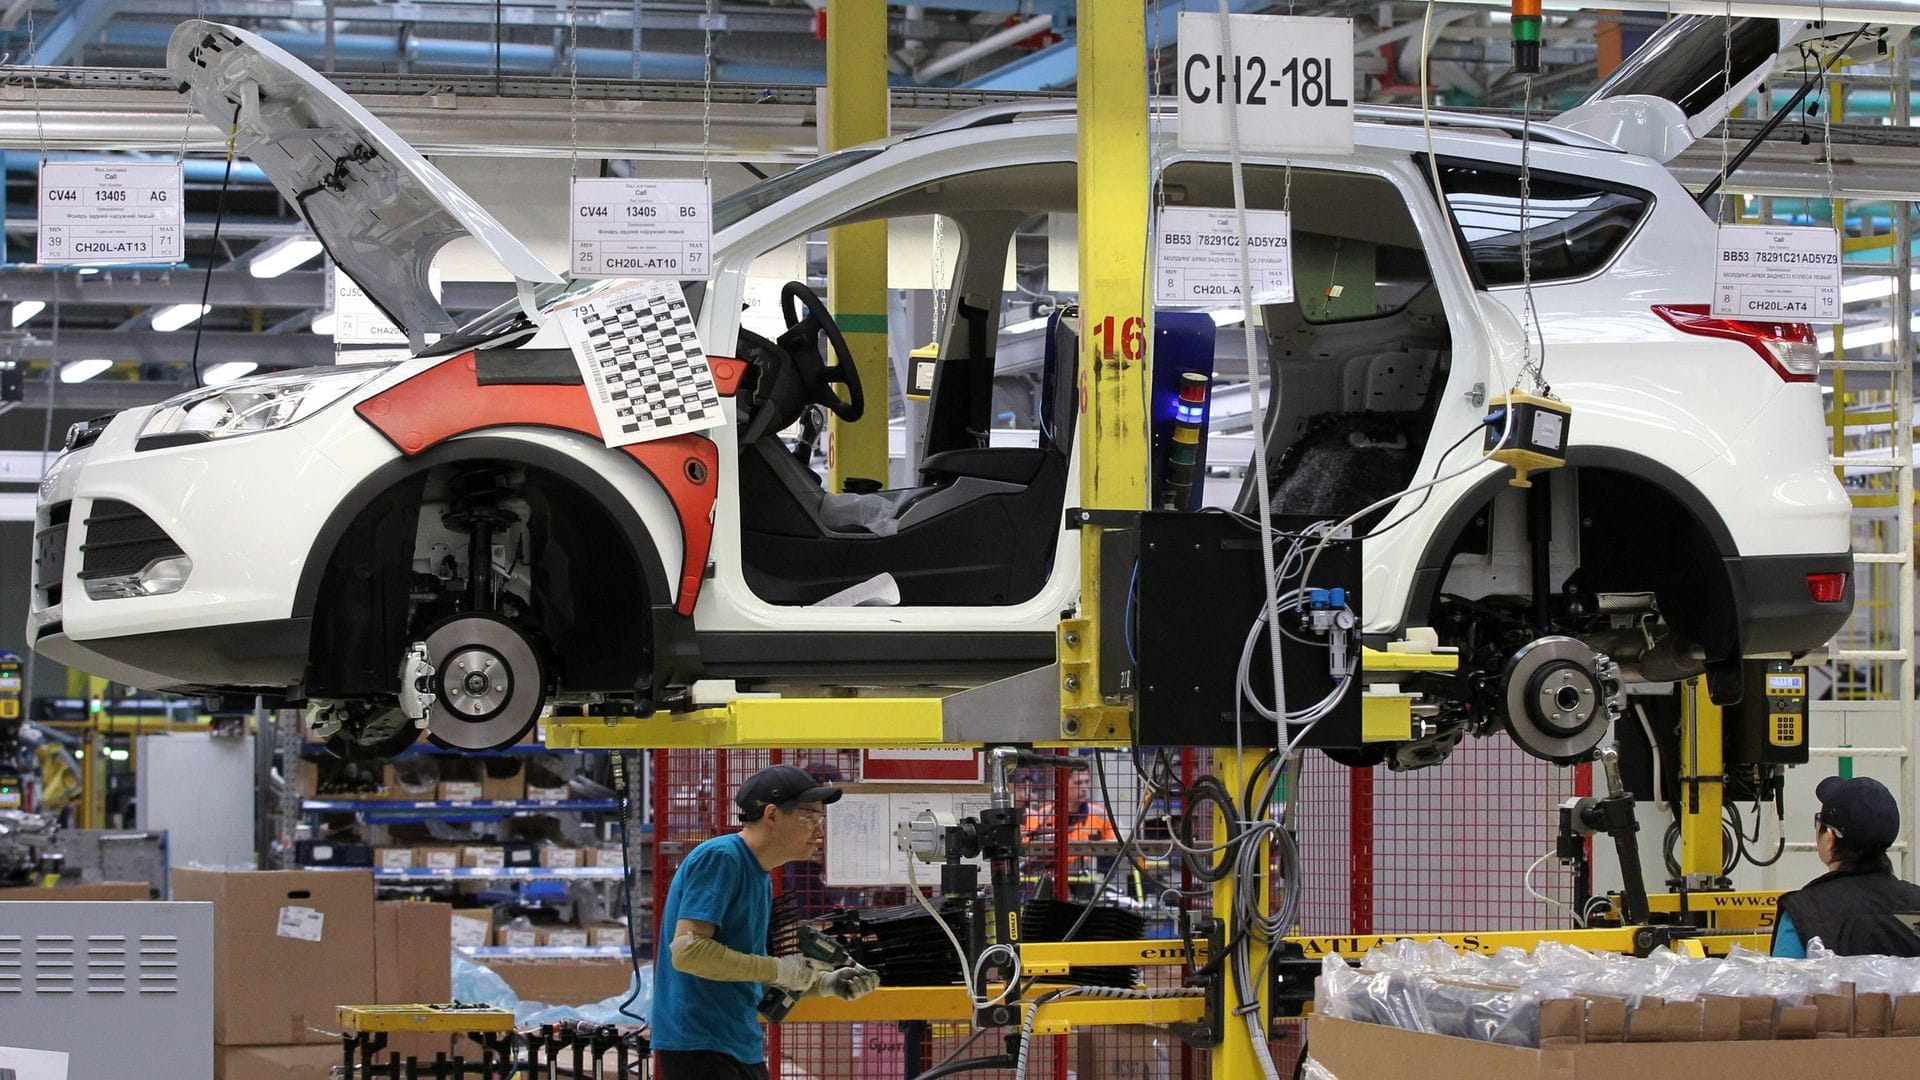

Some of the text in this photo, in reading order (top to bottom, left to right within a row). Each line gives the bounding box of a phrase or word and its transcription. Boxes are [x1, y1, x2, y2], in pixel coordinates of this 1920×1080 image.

[1185, 54, 1348, 107] CH2-18L
[49, 191, 166, 201] CV44 13405 AG
[580, 207, 696, 217] CV44 13405 BG
[49, 237, 61, 246] 39
[160, 236, 172, 244] 71
[1165, 234, 1287, 247] BB53 78291C2 AD5YZ9
[76, 243, 146, 252] CH20L-AT13
[580, 252, 593, 261] 25
[689, 253, 702, 262] 57
[1724, 252, 1837, 264] BB53 78291C21 AD5YZ9
[607, 259, 676, 268] CH20L-AT10
[1168, 279, 1174, 287] 8
[1724, 295, 1730, 303] 8
[1822, 297, 1832, 306] 19
[572, 303, 596, 318] 791
[1749, 301, 1807, 311] CH20L-AT4
[1093, 316, 1146, 360] 16
[1759, 912, 1775, 926] 5
